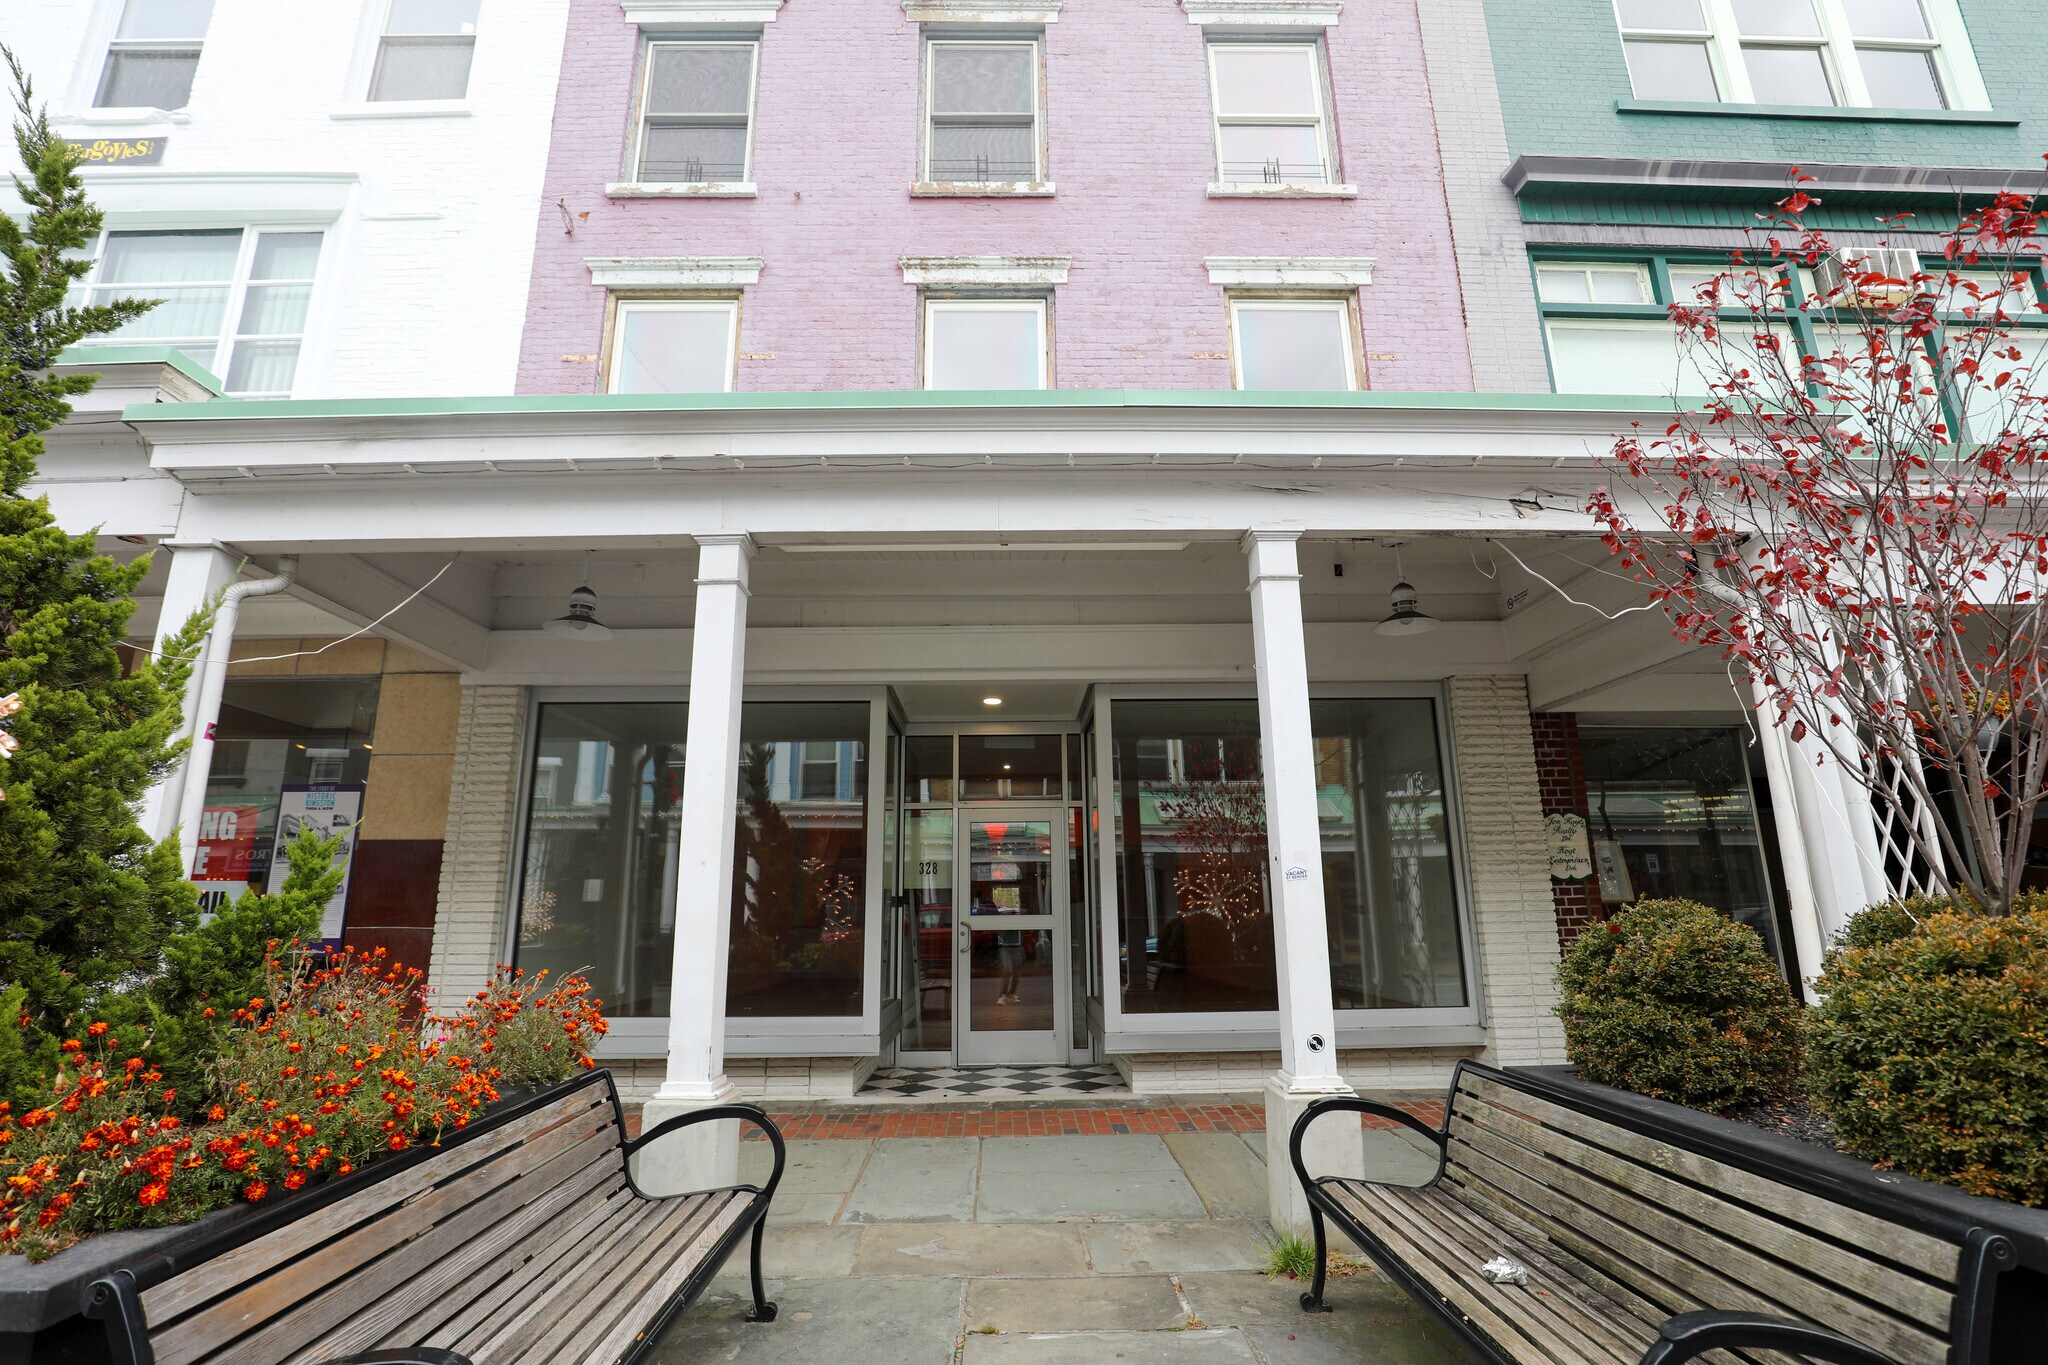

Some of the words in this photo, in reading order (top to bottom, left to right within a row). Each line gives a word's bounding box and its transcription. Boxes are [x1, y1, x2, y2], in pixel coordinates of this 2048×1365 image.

[306, 792, 336, 800] HISTORIC
[1552, 826, 1577, 837] Realty
[919, 861, 938, 875] 328
